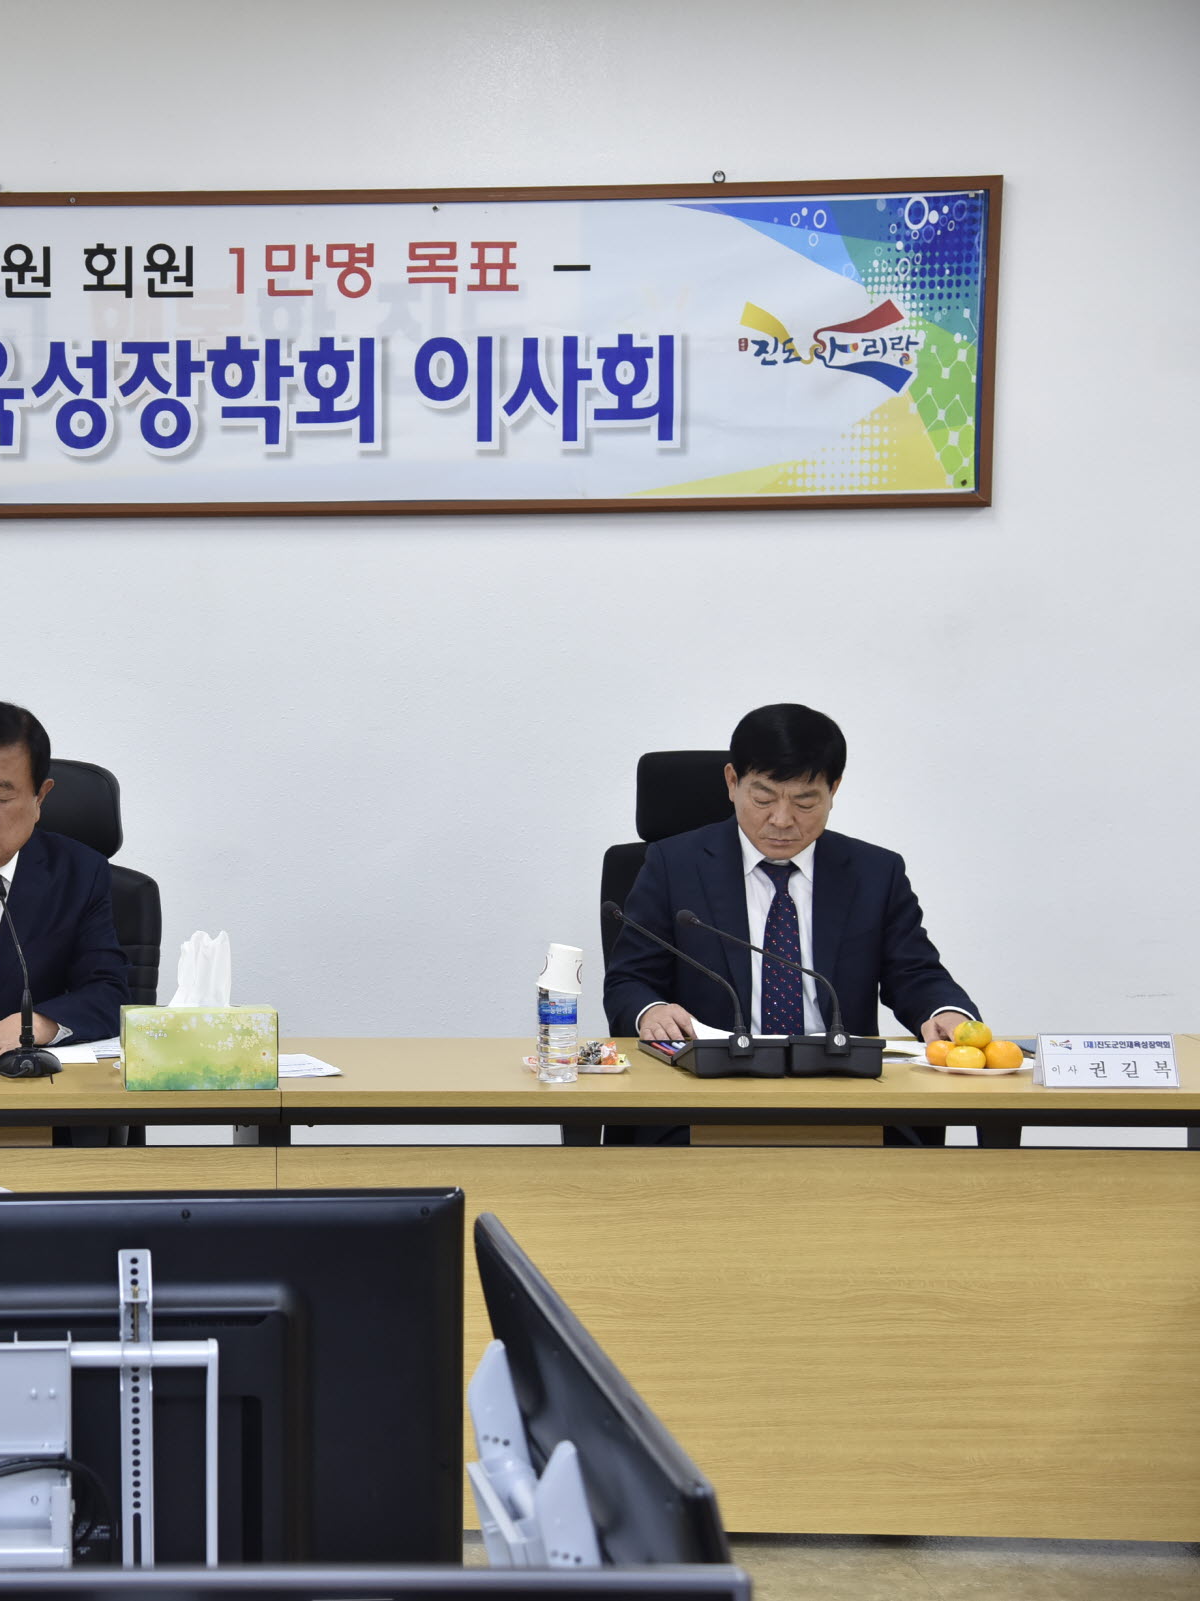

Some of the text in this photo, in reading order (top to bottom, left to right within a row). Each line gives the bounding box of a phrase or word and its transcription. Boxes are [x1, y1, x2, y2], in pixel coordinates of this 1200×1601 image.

[83, 242, 194, 300] 회원
[228, 241, 375, 299] 1만명
[406, 240, 519, 294] 목표
[414, 332, 677, 443] 이사회
